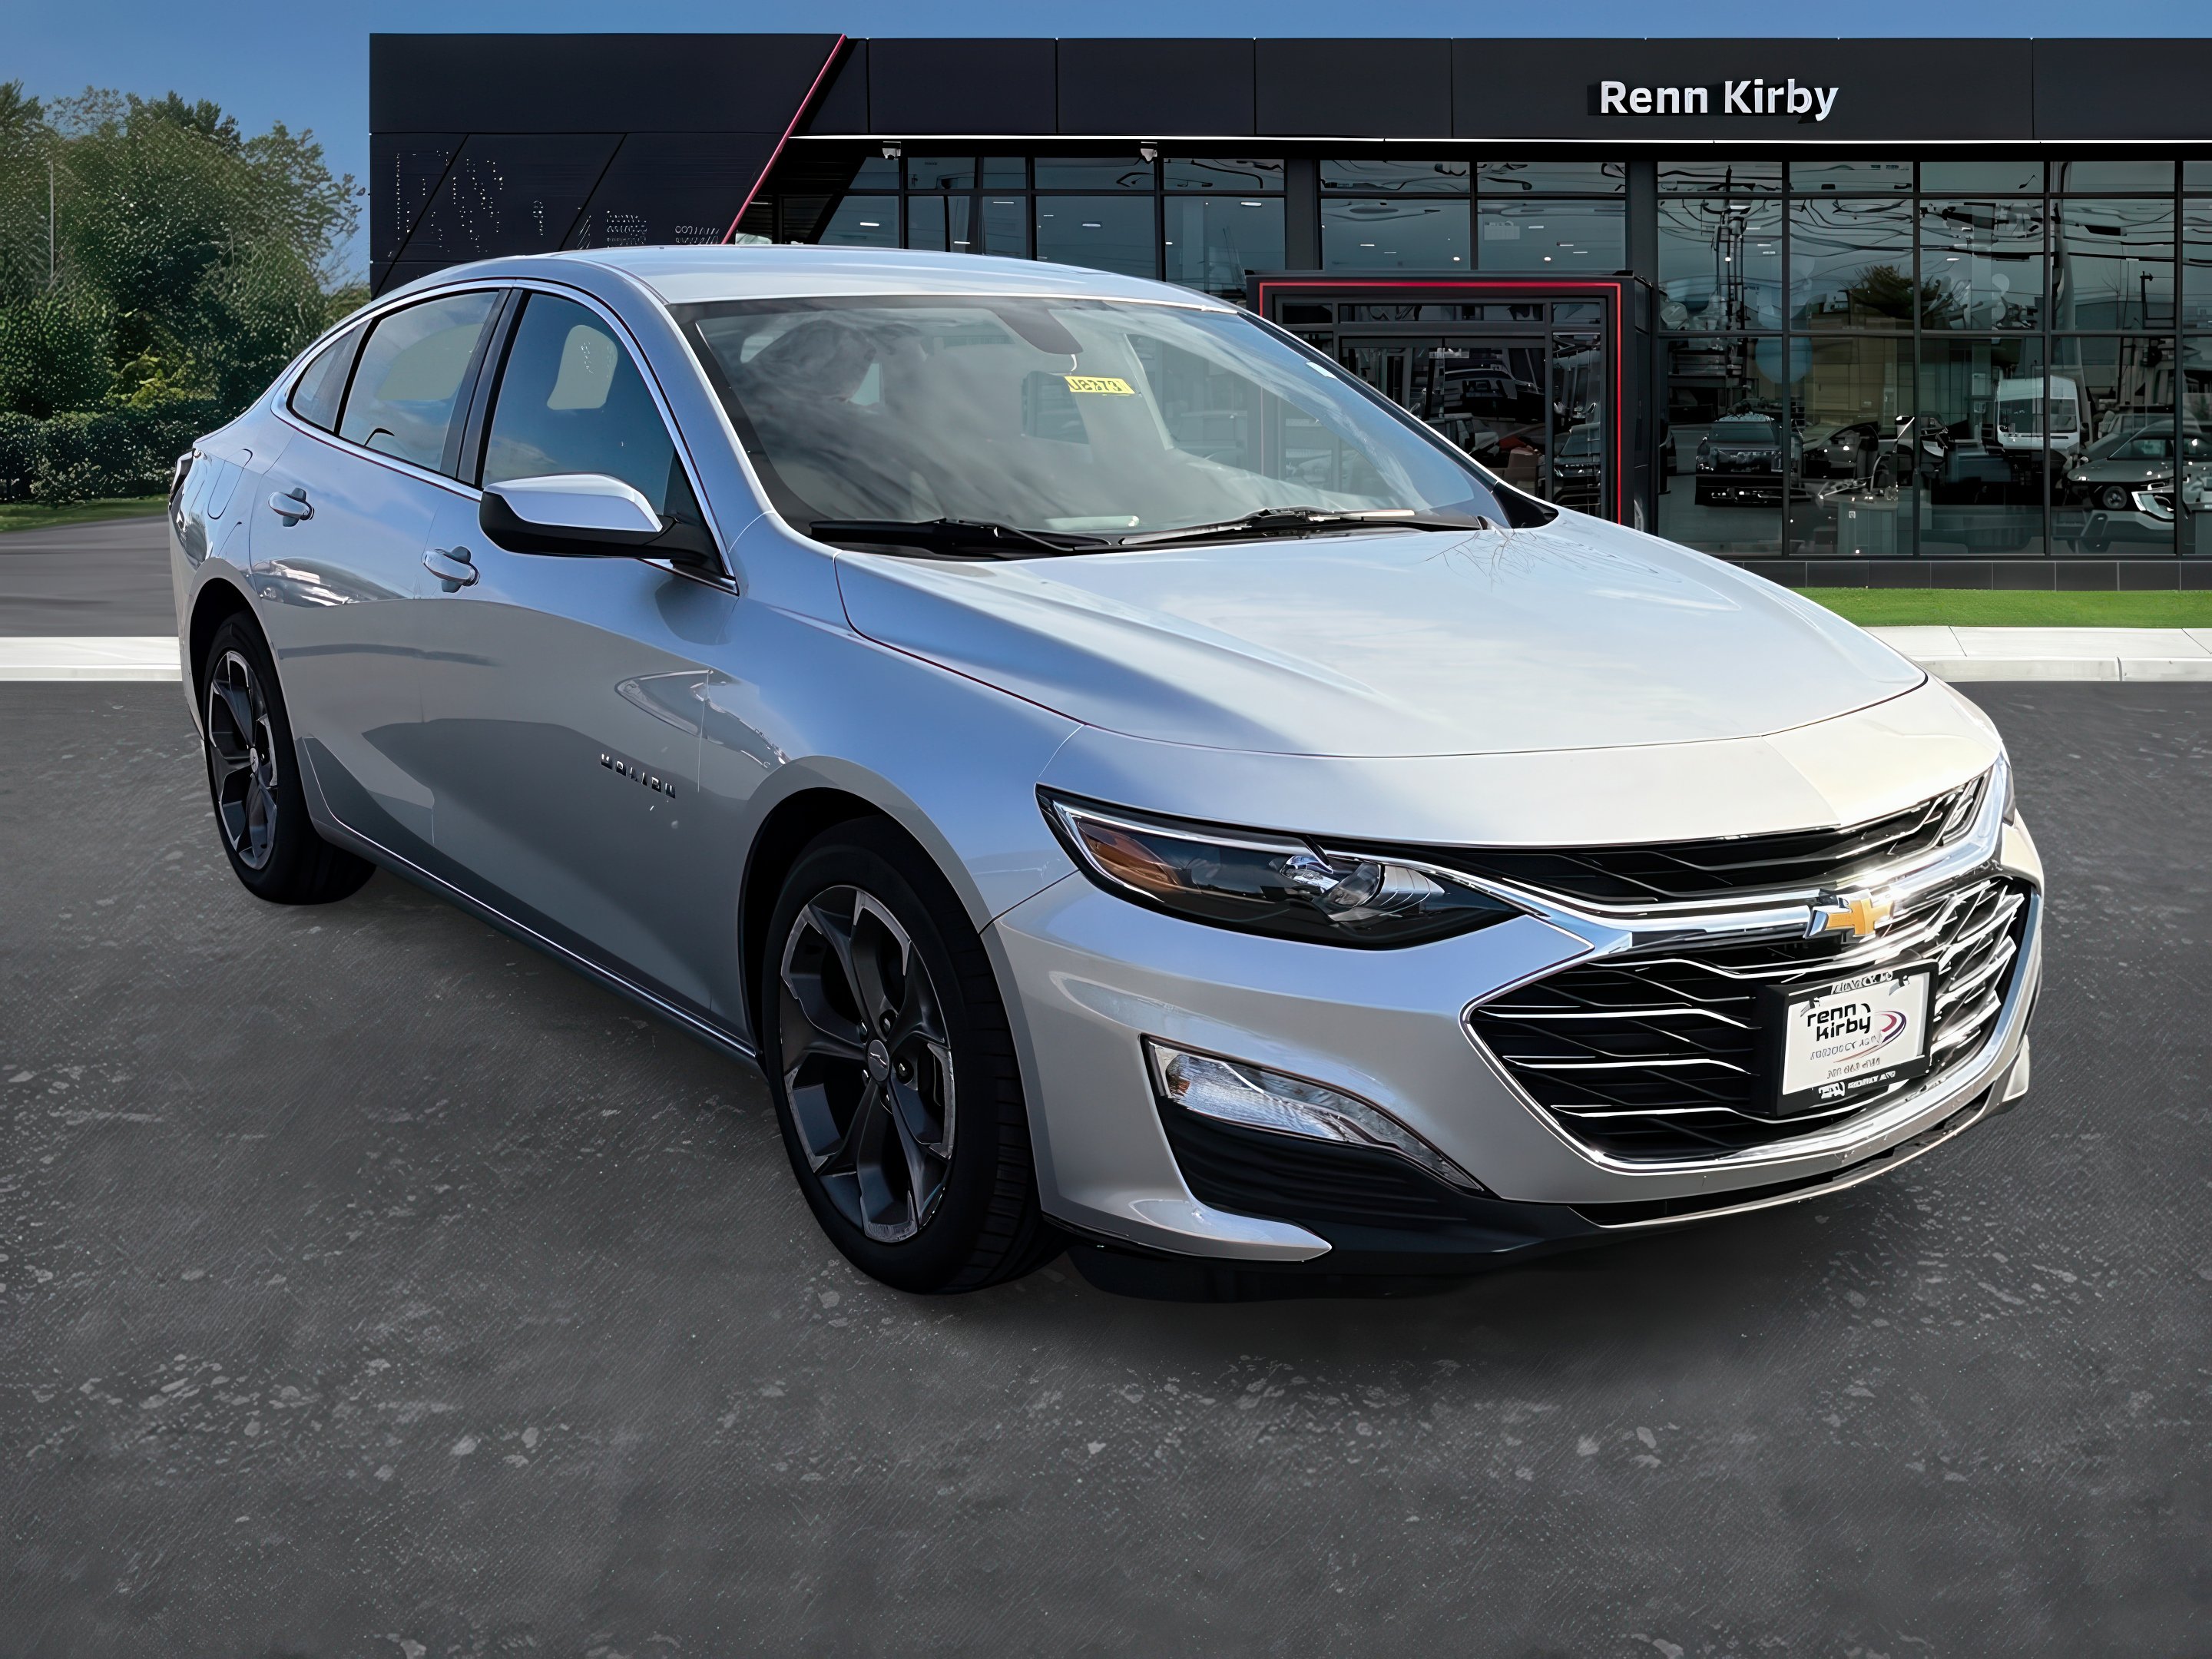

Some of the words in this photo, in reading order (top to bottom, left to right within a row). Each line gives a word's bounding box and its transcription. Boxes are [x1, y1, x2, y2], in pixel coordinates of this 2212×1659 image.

[1601, 81, 1708, 114] Renn
[1724, 78, 1839, 121] Kirby
[1807, 1003, 1856, 1028] renn
[1816, 1015, 1871, 1041] kirby
